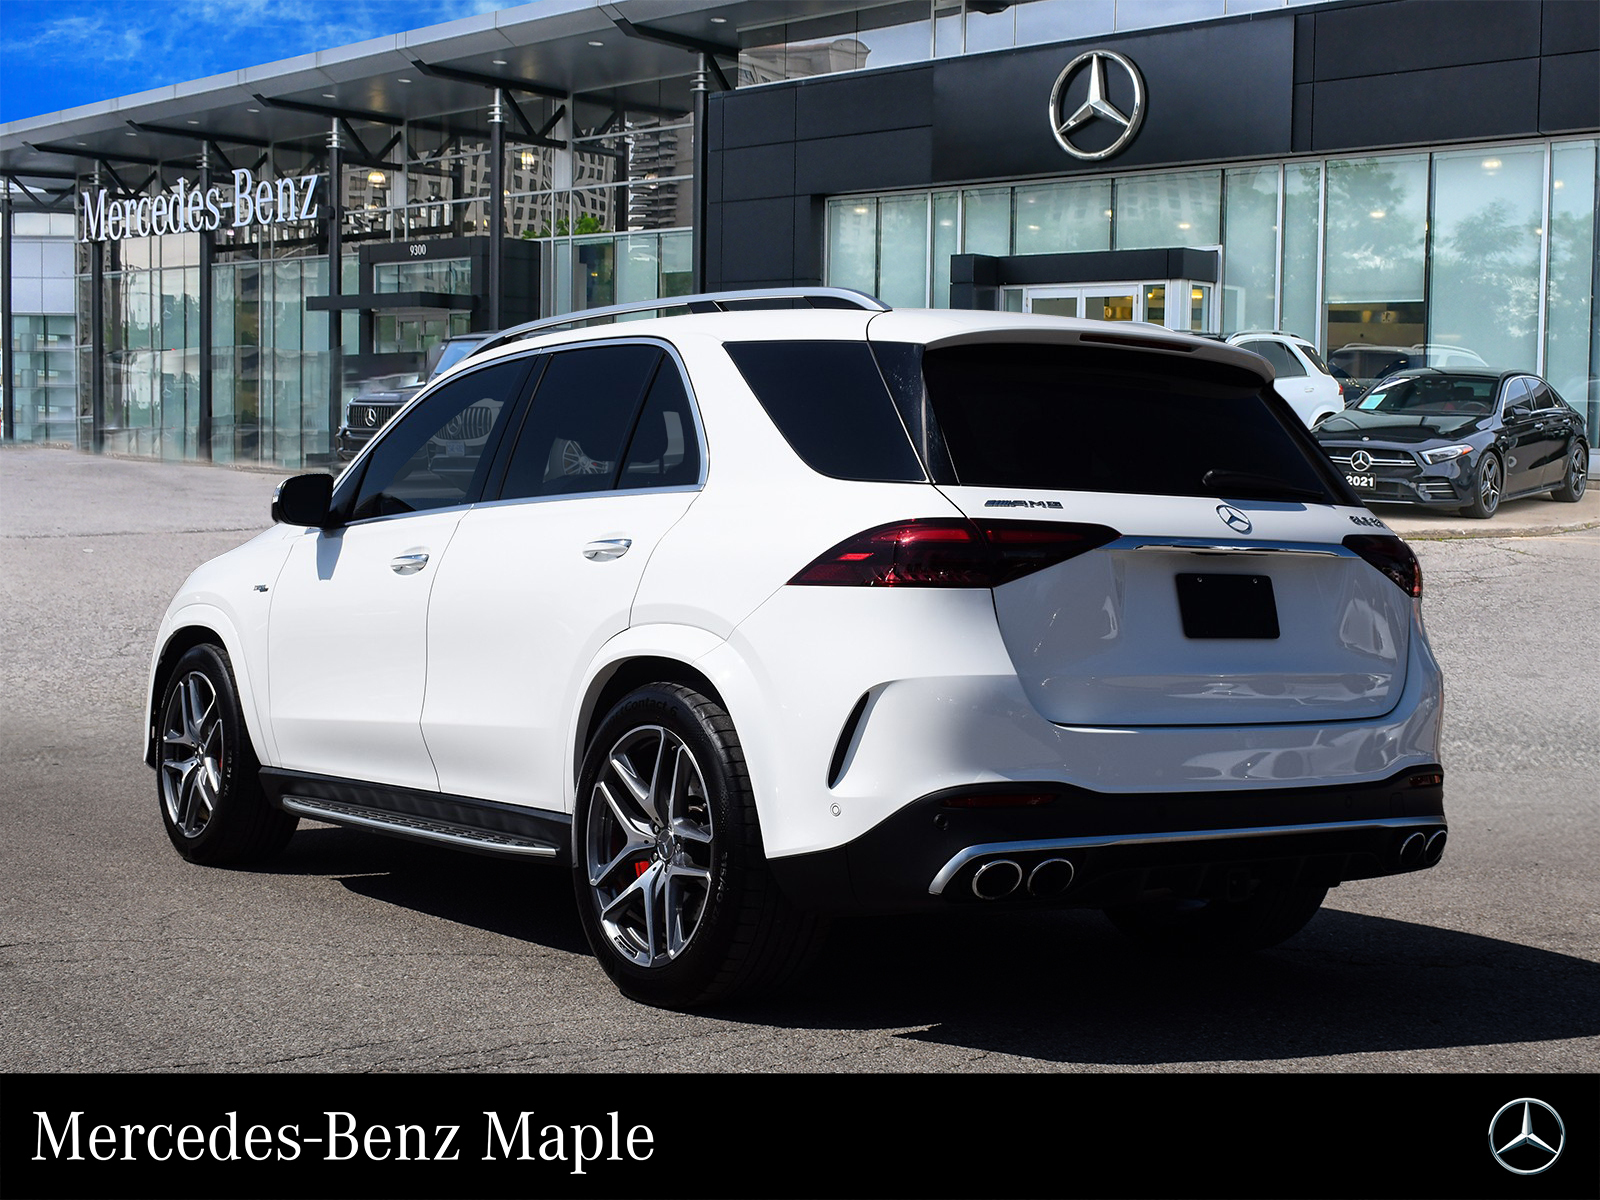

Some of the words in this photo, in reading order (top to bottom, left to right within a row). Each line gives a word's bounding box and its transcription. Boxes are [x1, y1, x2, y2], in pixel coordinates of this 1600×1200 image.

[82, 167, 319, 243] Mercedes-Benz
[409, 244, 427, 257] 9300
[1345, 475, 1374, 487] 2021
